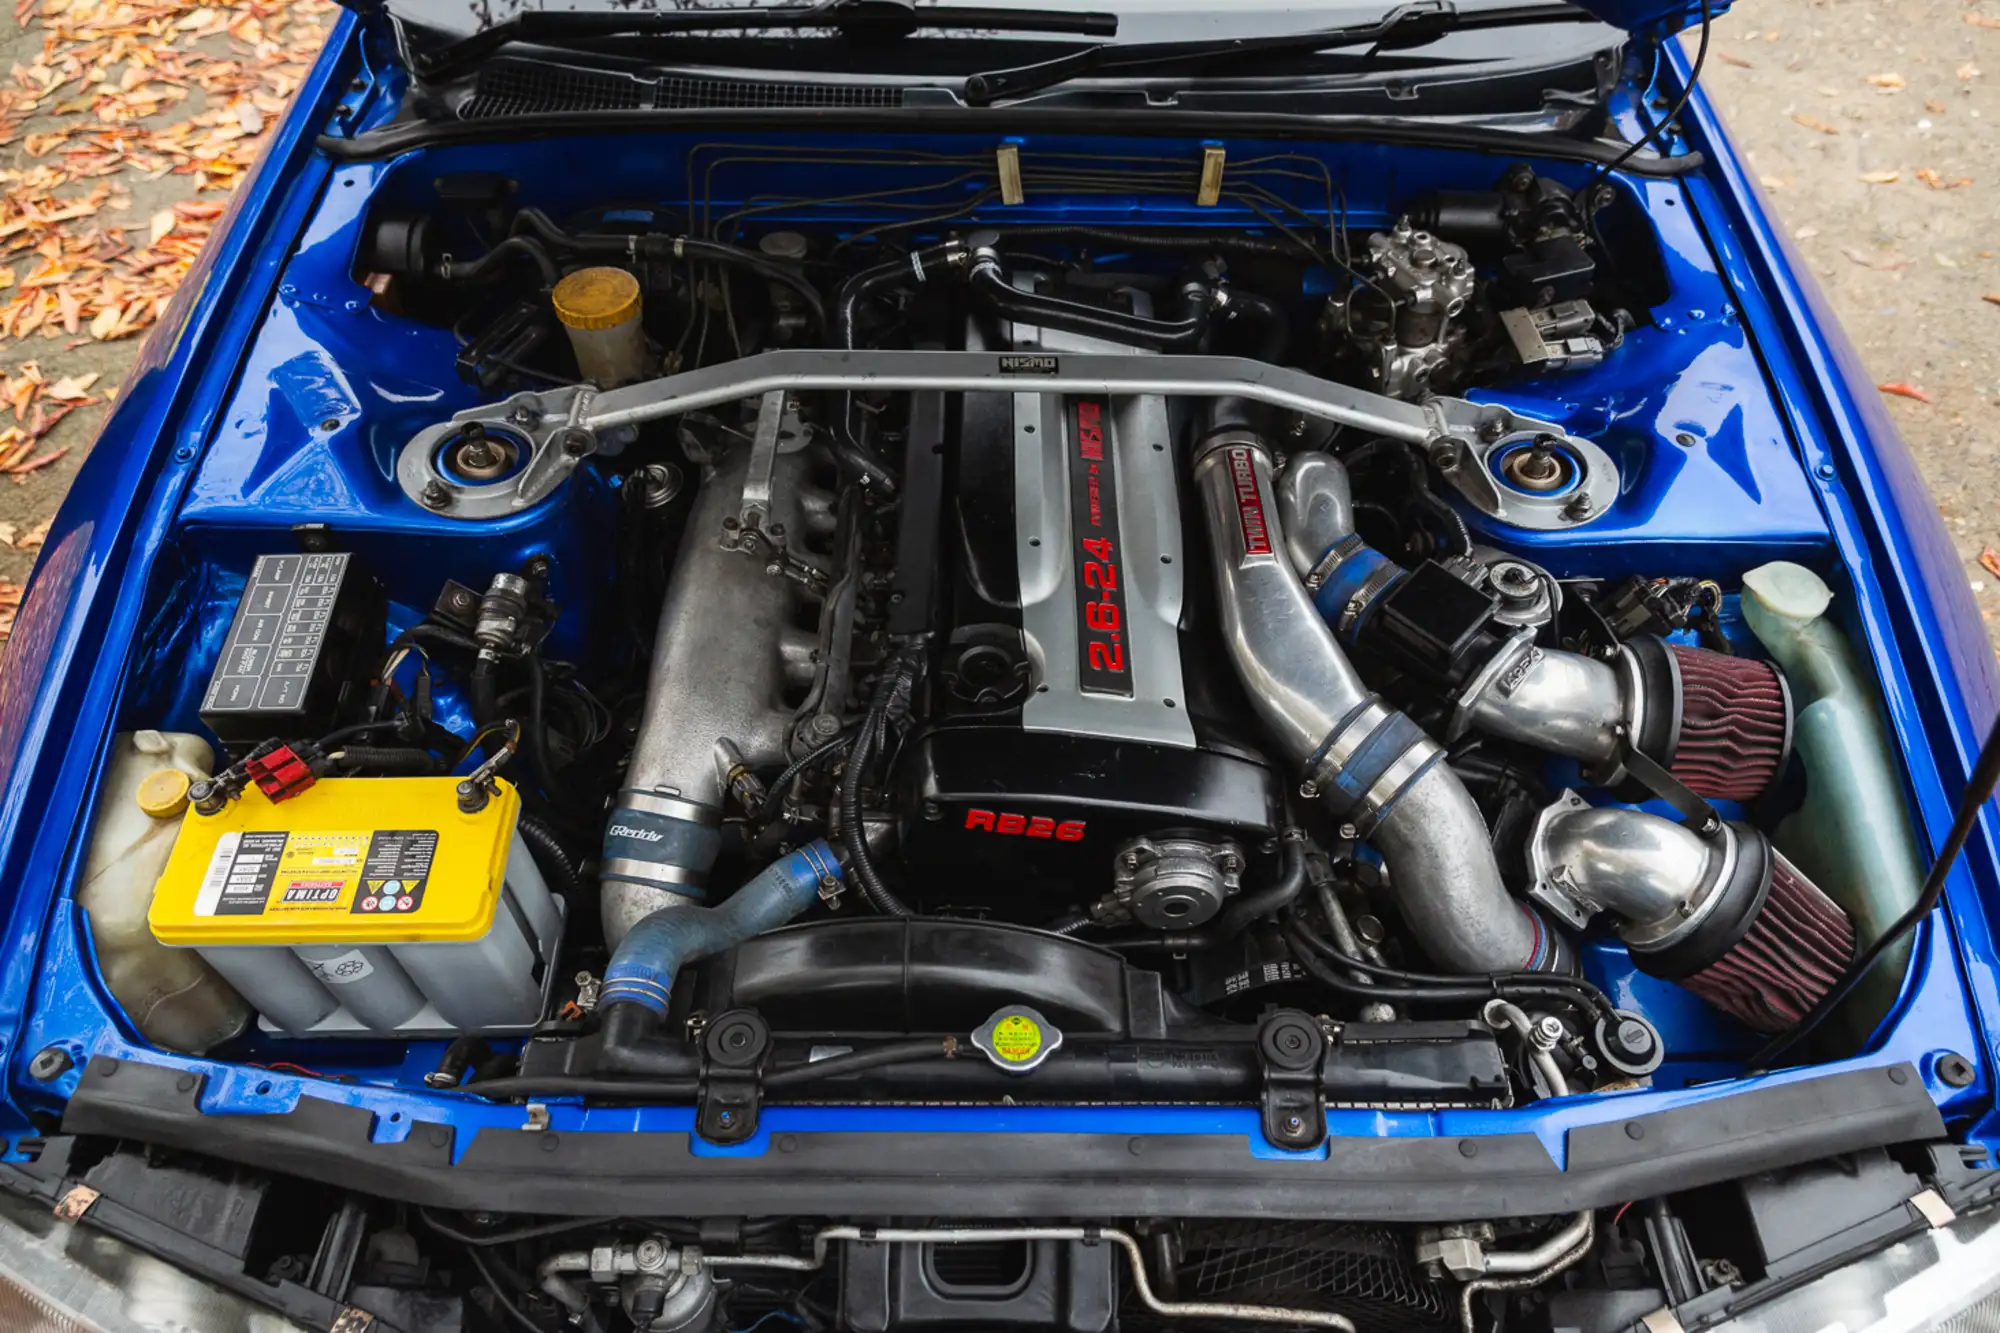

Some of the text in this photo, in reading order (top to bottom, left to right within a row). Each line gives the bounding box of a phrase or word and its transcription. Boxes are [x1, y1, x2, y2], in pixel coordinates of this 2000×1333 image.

[1001, 357, 1056, 369] NISMO
[1078, 401, 1104, 460] NISMO
[1231, 449, 1267, 551] TWIN TURBO
[1083, 537, 1124, 673] 2.6-24
[964, 808, 1087, 841] RB26
[286, 888, 339, 902] OPTIMA
